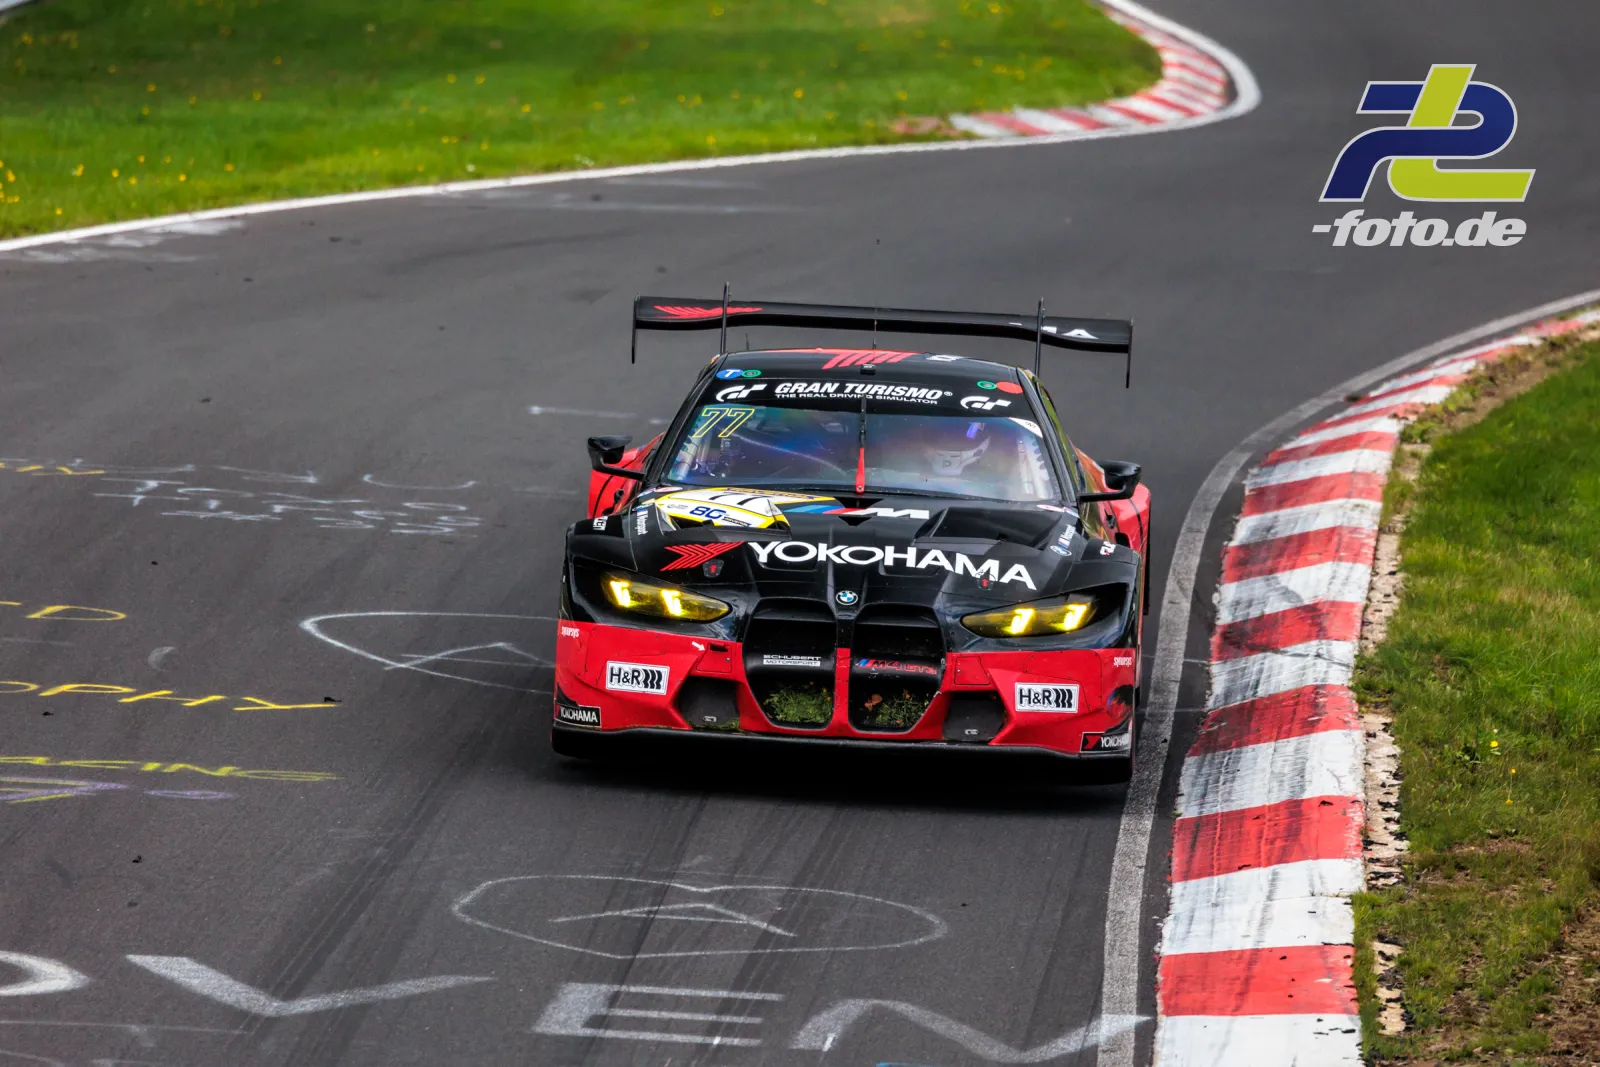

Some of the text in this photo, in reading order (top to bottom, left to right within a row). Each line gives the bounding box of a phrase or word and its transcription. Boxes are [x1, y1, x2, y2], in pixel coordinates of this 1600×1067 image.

[775, 382, 840, 394] GRAN
[875, 395, 938, 405] SIMULATOR
[692, 407, 755, 438] 77
[748, 541, 1037, 591] YOKOHAMA
[609, 666, 641, 686] H&R
[1018, 688, 1053, 706] H&R
